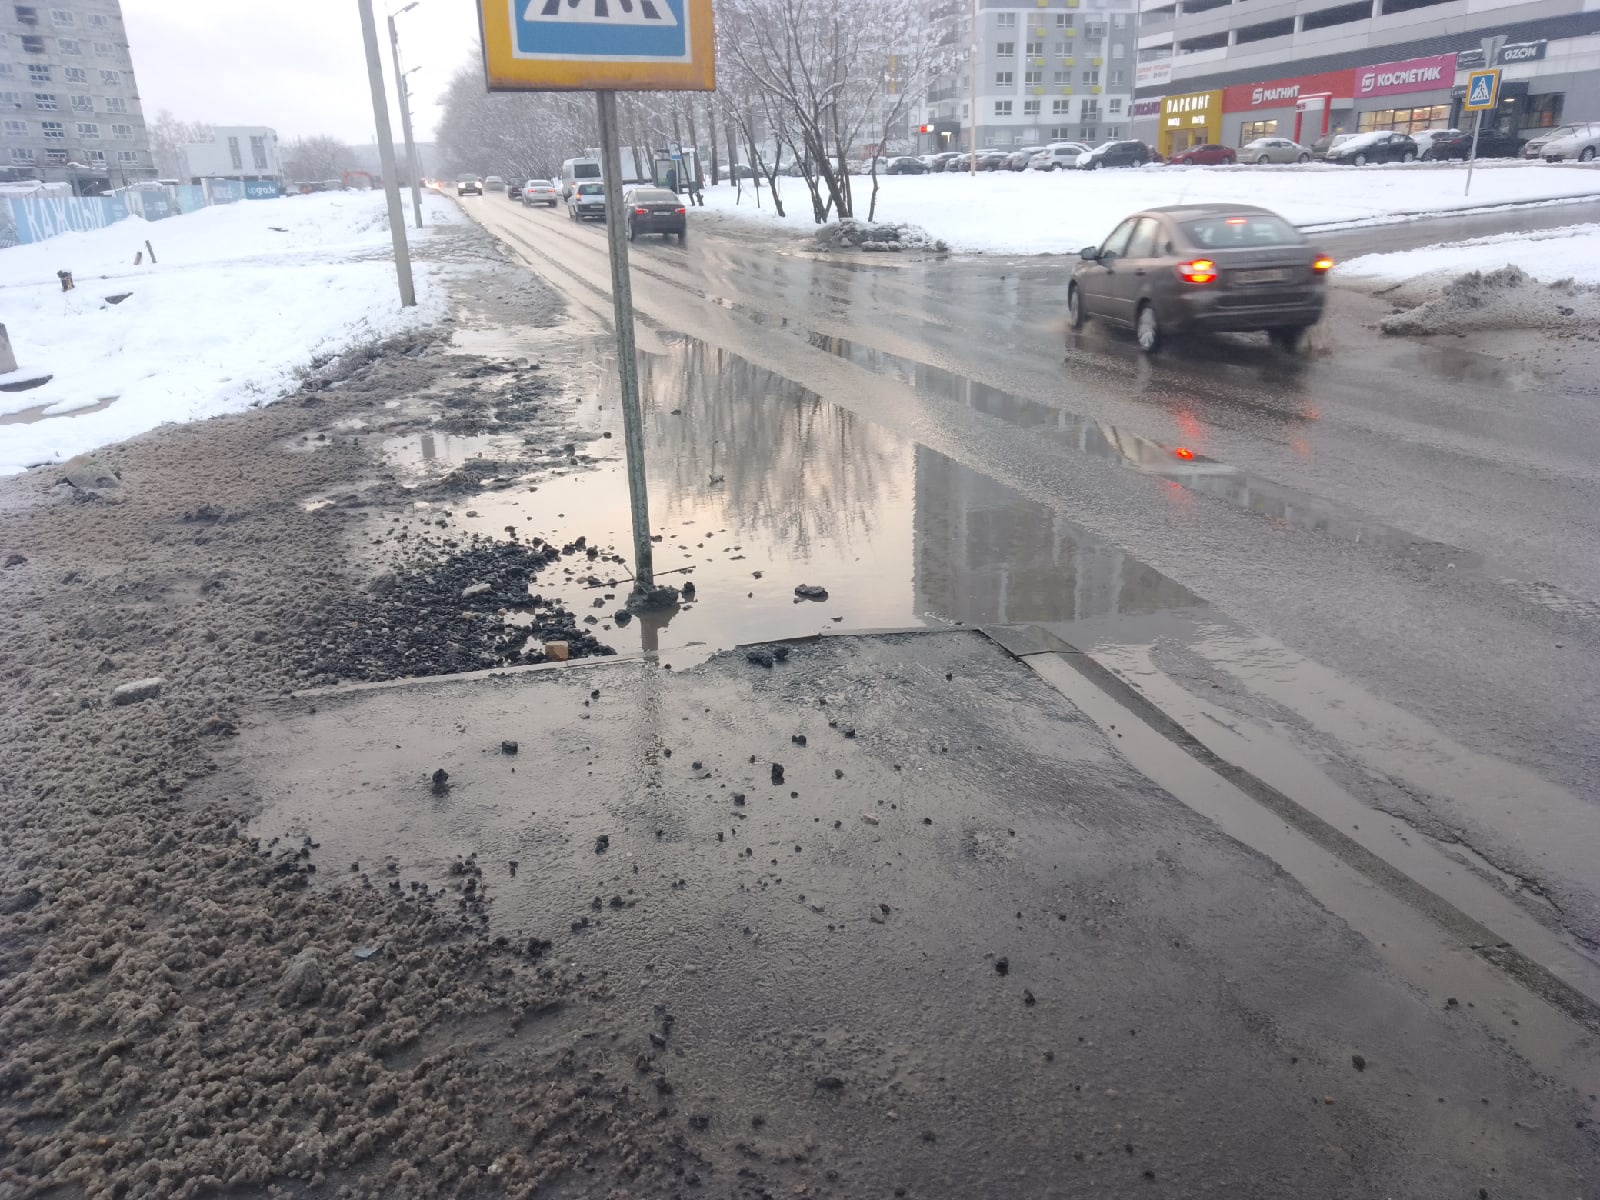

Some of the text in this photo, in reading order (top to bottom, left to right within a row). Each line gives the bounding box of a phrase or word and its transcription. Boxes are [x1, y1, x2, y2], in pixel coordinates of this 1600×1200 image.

[1504, 46, 1537, 60] OZON
[1377, 66, 1442, 87] КОСМЕТИК
[1263, 85, 1300, 101] МАГНИТ
[1166, 95, 1210, 113] ПАРКИНГ
[247, 184, 276, 198] upgrade
